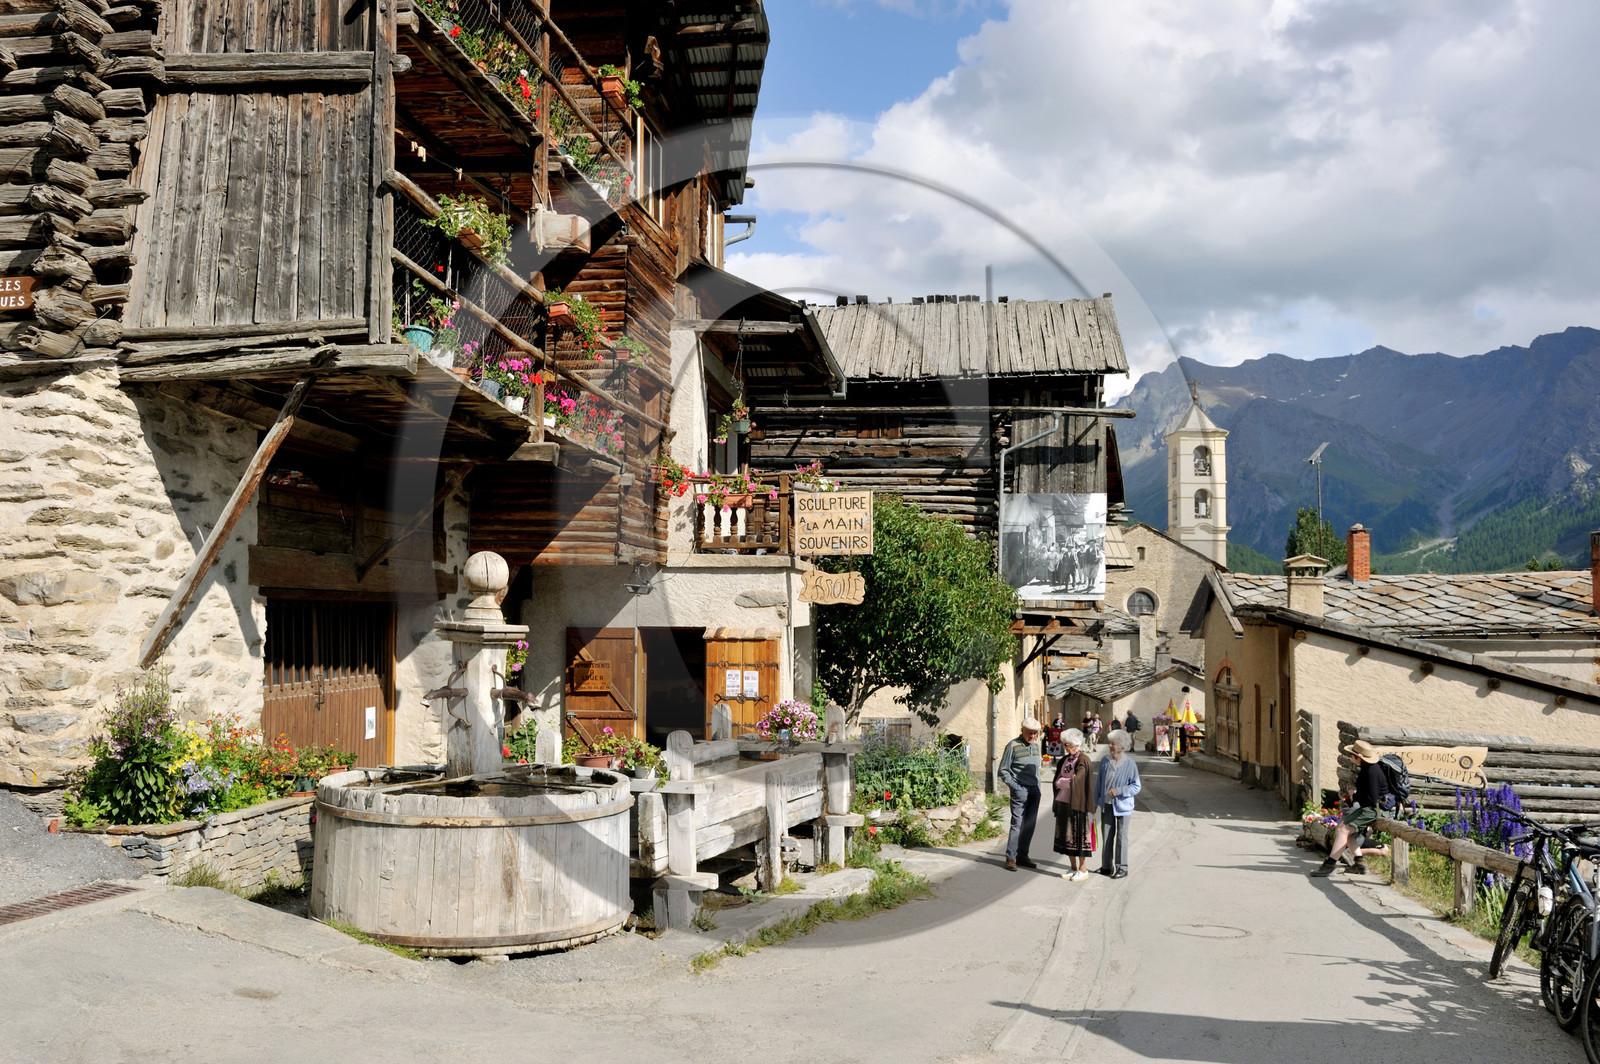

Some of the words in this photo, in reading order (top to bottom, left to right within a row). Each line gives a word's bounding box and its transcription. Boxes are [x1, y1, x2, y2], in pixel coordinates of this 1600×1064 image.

[799, 496, 867, 511] SCULPTURE
[806, 522, 819, 531] LA
[823, 517, 864, 531] MAIN
[799, 535, 869, 550] SOUVENIRS
[1421, 753, 1433, 761] EN
[1436, 753, 1457, 764] BOIS
